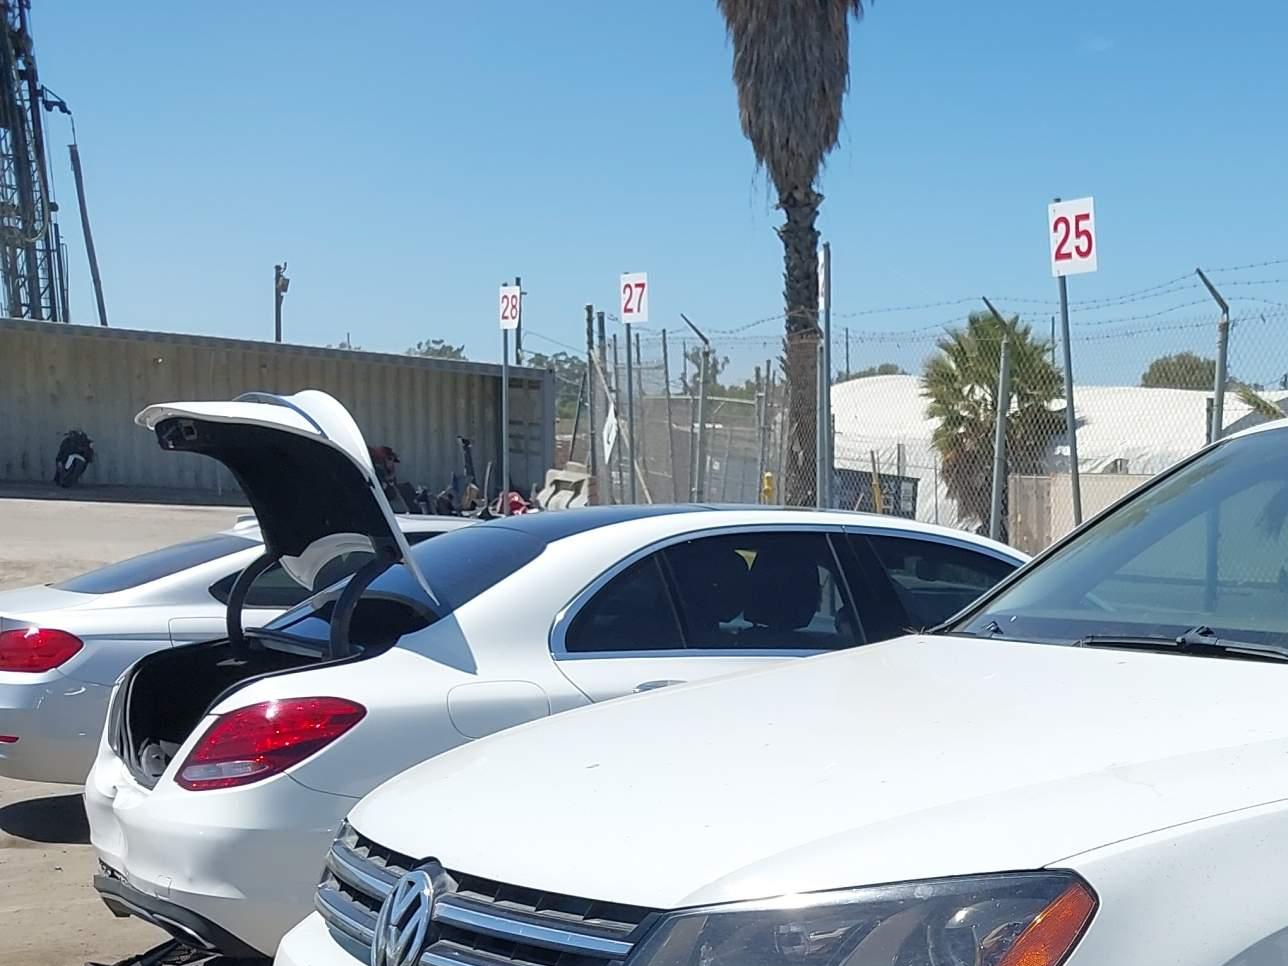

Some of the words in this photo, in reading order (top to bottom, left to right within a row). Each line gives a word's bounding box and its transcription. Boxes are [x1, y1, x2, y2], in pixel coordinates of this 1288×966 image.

[1053, 212, 1093, 262] 25
[501, 294, 518, 320] 28
[622, 282, 646, 314] 27
